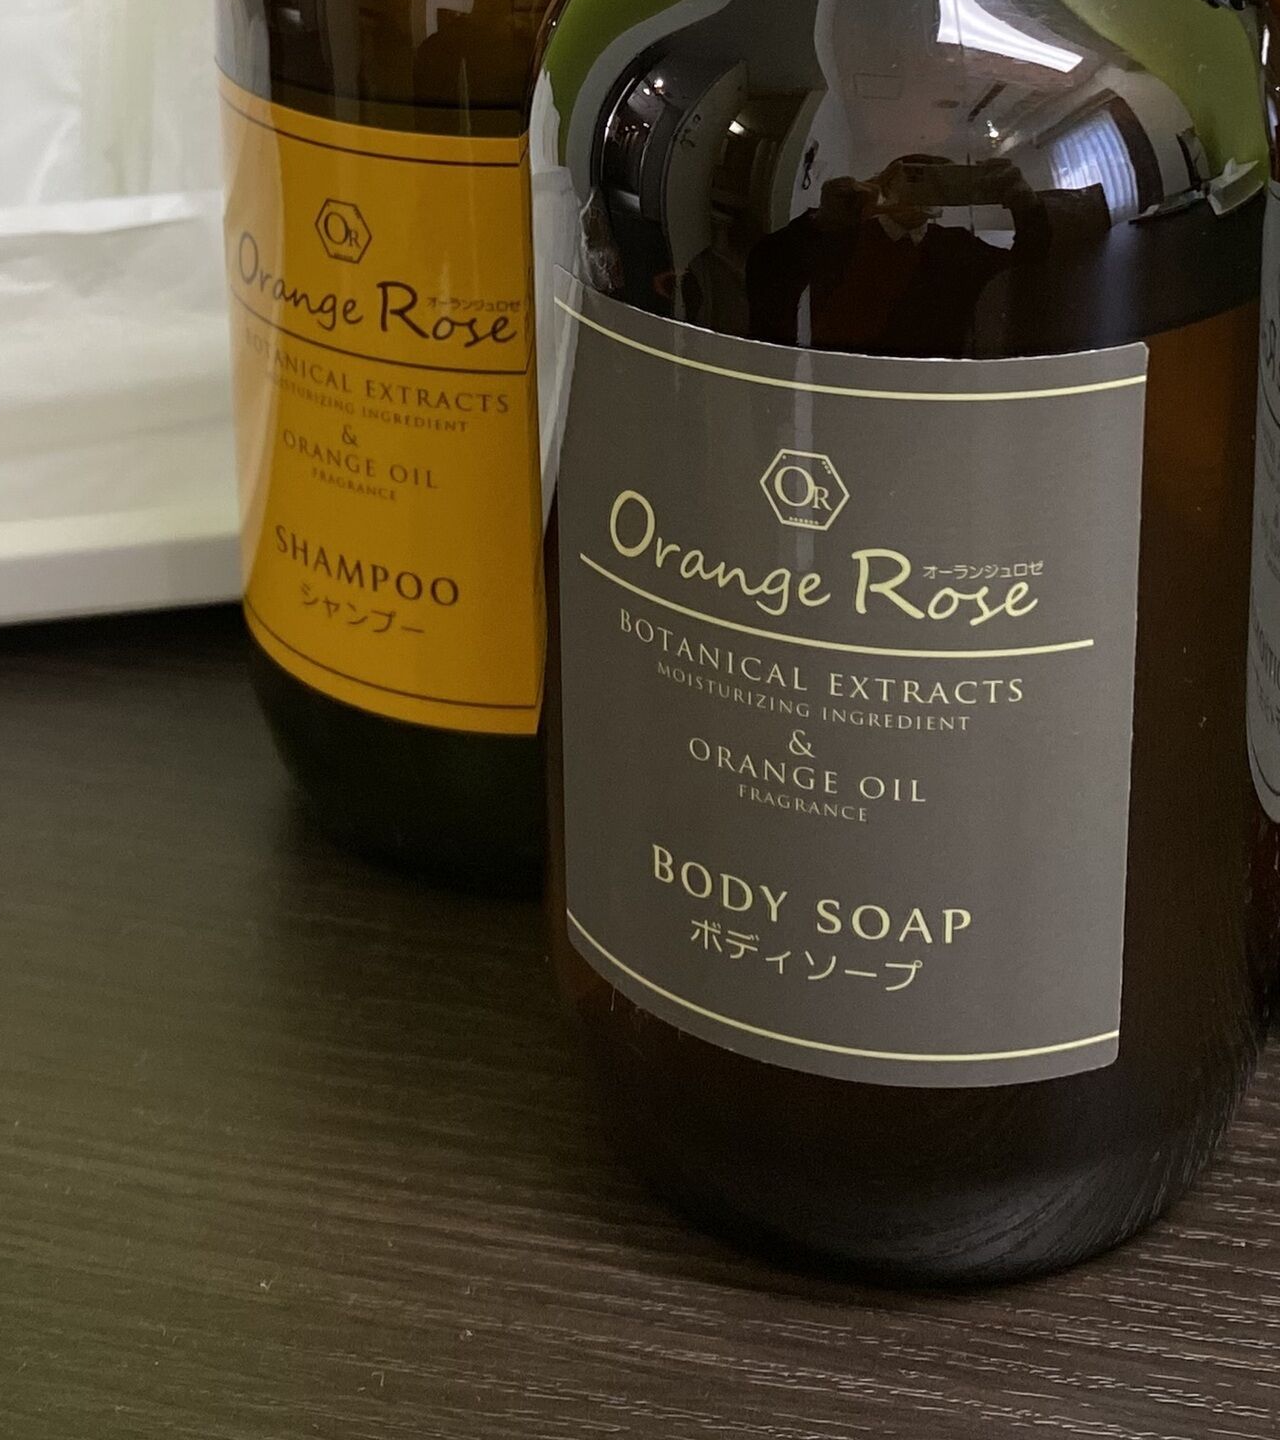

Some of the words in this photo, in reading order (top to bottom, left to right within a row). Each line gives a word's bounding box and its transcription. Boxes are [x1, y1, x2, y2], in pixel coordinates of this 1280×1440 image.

[238, 231, 364, 331] Orange
[376, 281, 517, 348] Rose
[361, 407, 468, 432] INGREDIENT
[365, 379, 509, 413] EXTRACTS
[283, 429, 376, 477] ORANGE
[389, 464, 438, 489] OIL
[341, 424, 358, 446] &
[311, 468, 396, 501] FRAGRANCE
[275, 524, 459, 606] SHAMPOO
[609, 490, 831, 616] Orange
[852, 548, 1039, 626] Rose
[922, 560, 1044, 579] オーランジュロゼ
[300, 582, 424, 634] シャンプー
[620, 608, 808, 691] BOTANICAL
[829, 672, 1024, 704] EXTRACTS
[656, 661, 810, 719] MOISTURIZING
[822, 706, 971, 732] INGREDIENT
[689, 736, 839, 795] ORANGE
[859, 775, 926, 803] OIL
[788, 728, 816, 758] &
[738, 783, 869, 823] FRAGRANCE
[652, 843, 788, 923] BODY
[816, 898, 972, 945] SOAP
[690, 918, 923, 991] ボディソープ
